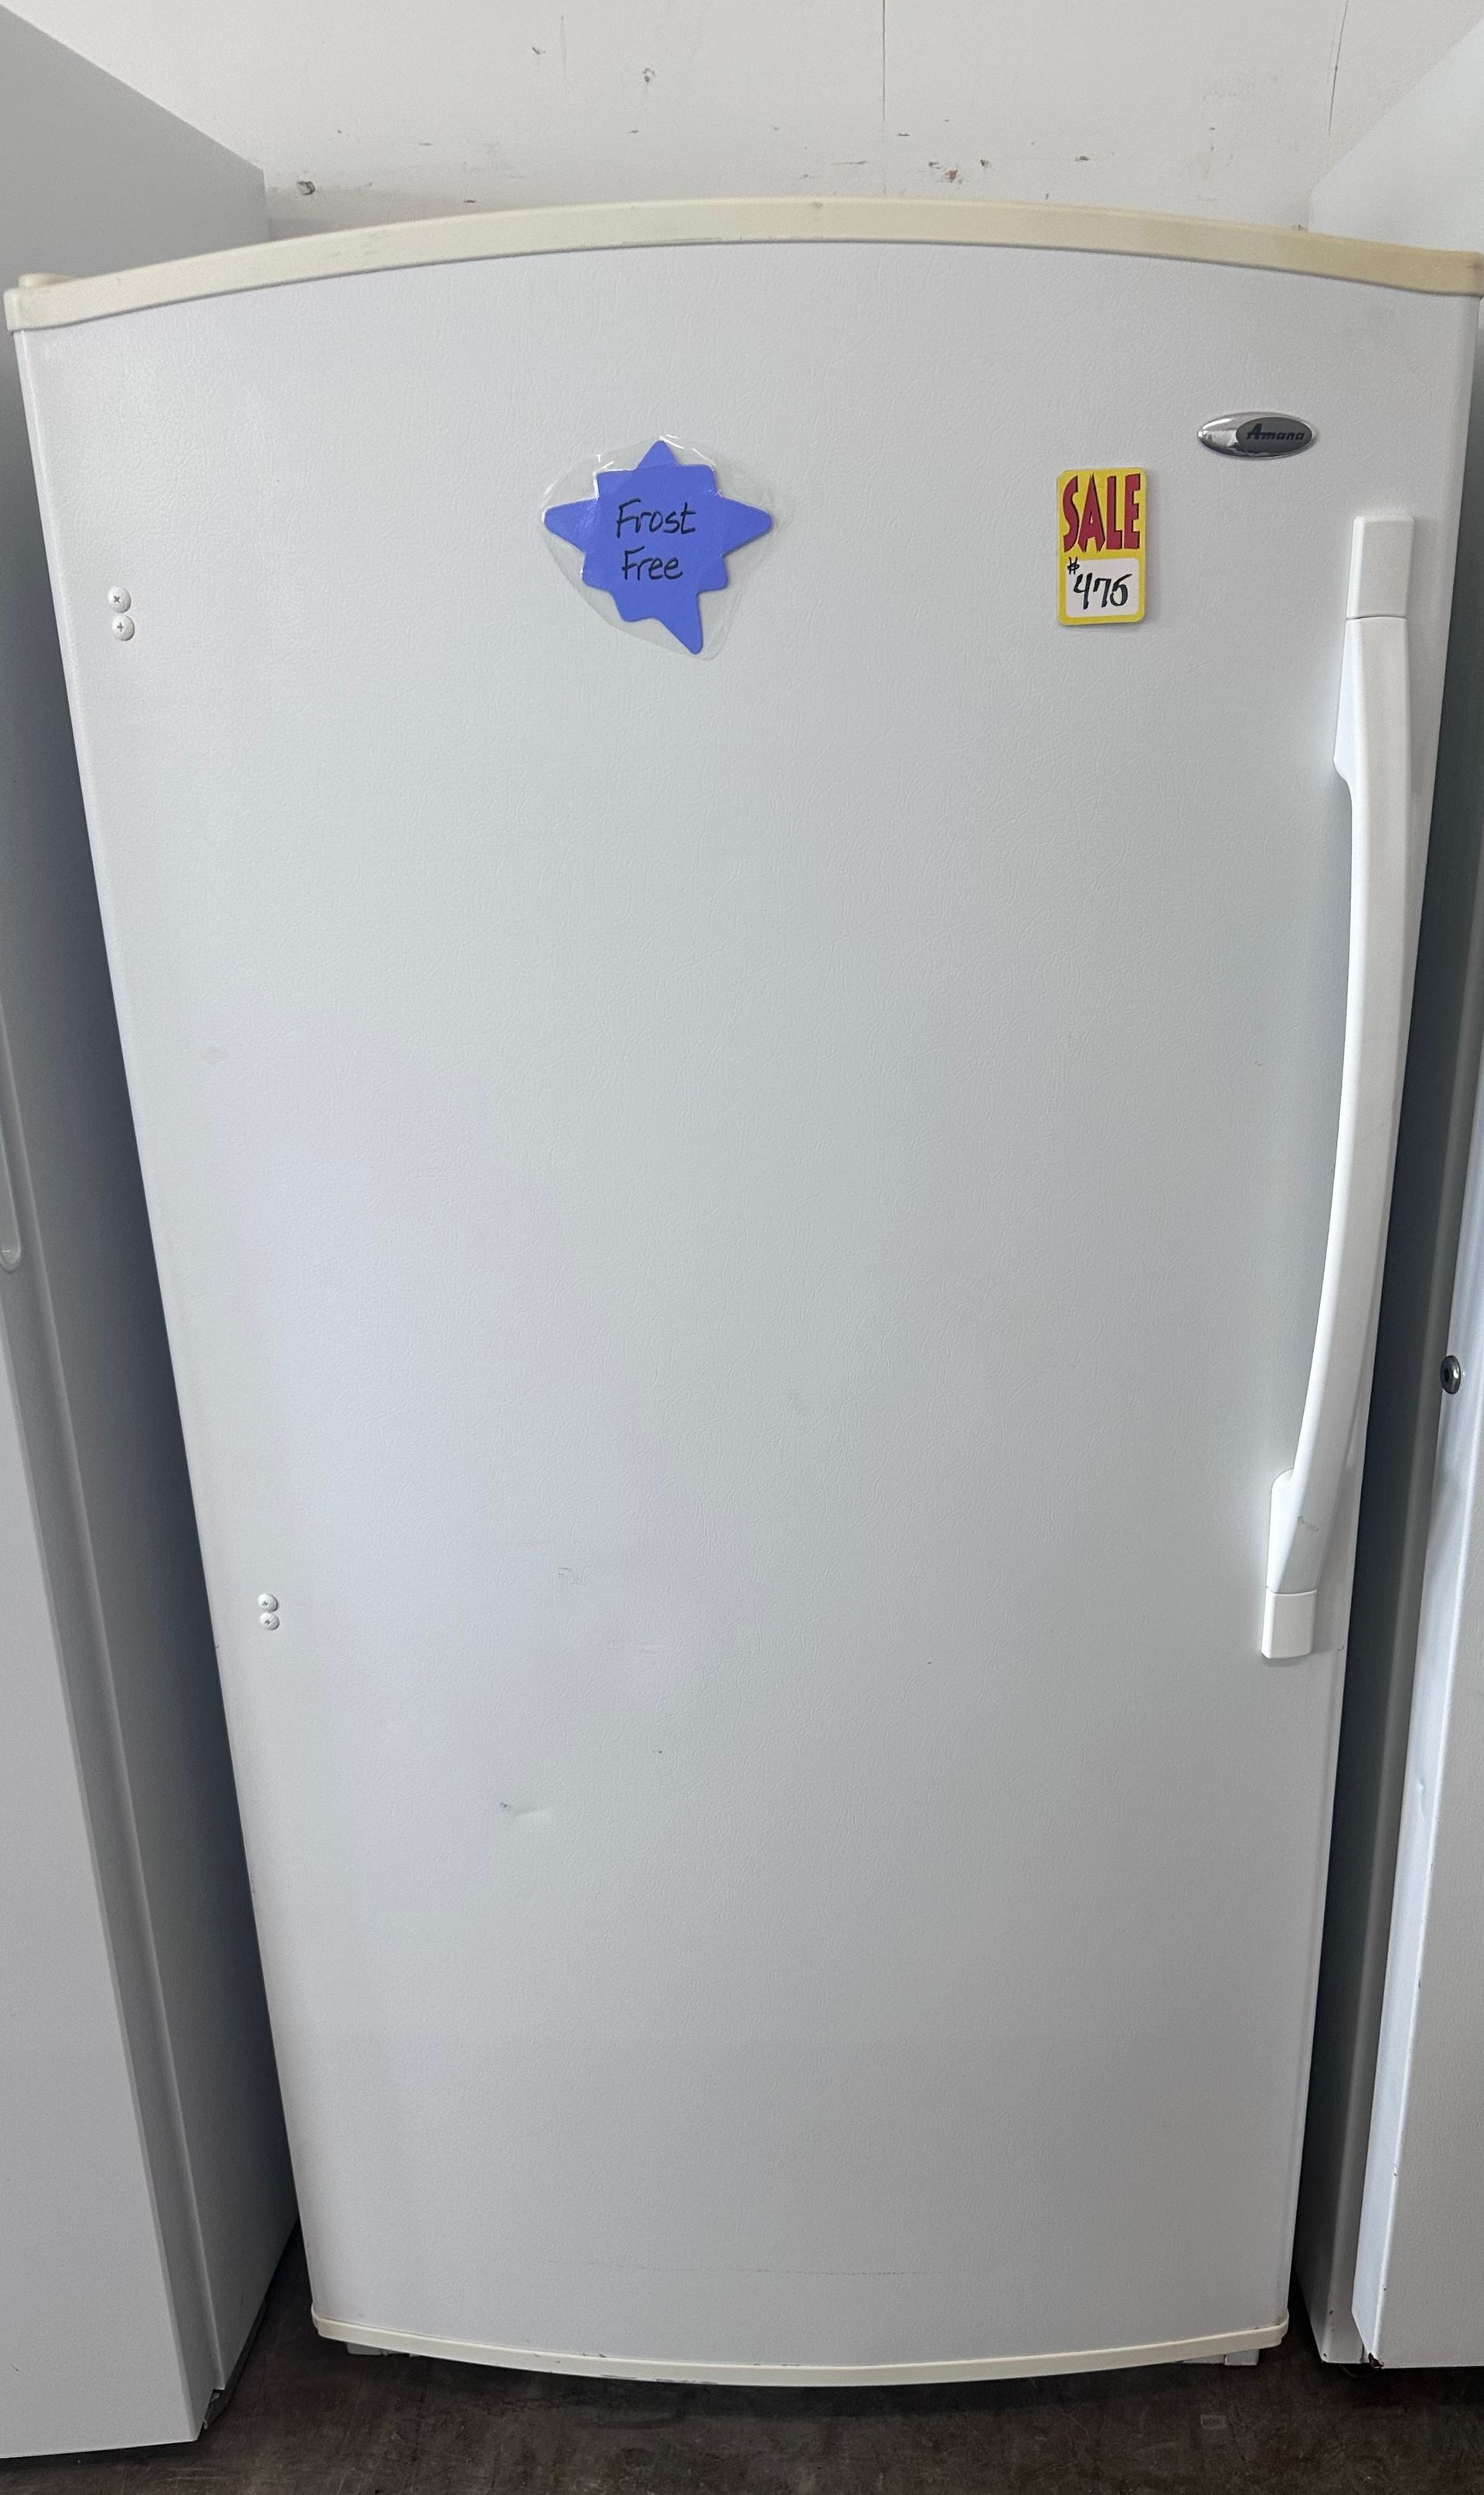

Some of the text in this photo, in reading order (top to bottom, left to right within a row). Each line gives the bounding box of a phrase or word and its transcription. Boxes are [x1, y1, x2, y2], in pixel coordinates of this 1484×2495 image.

[1246, 423, 1305, 441] Amana
[617, 498, 696, 538] Frost
[1062, 472, 1141, 553] SALE
[621, 546, 683, 580] Free
